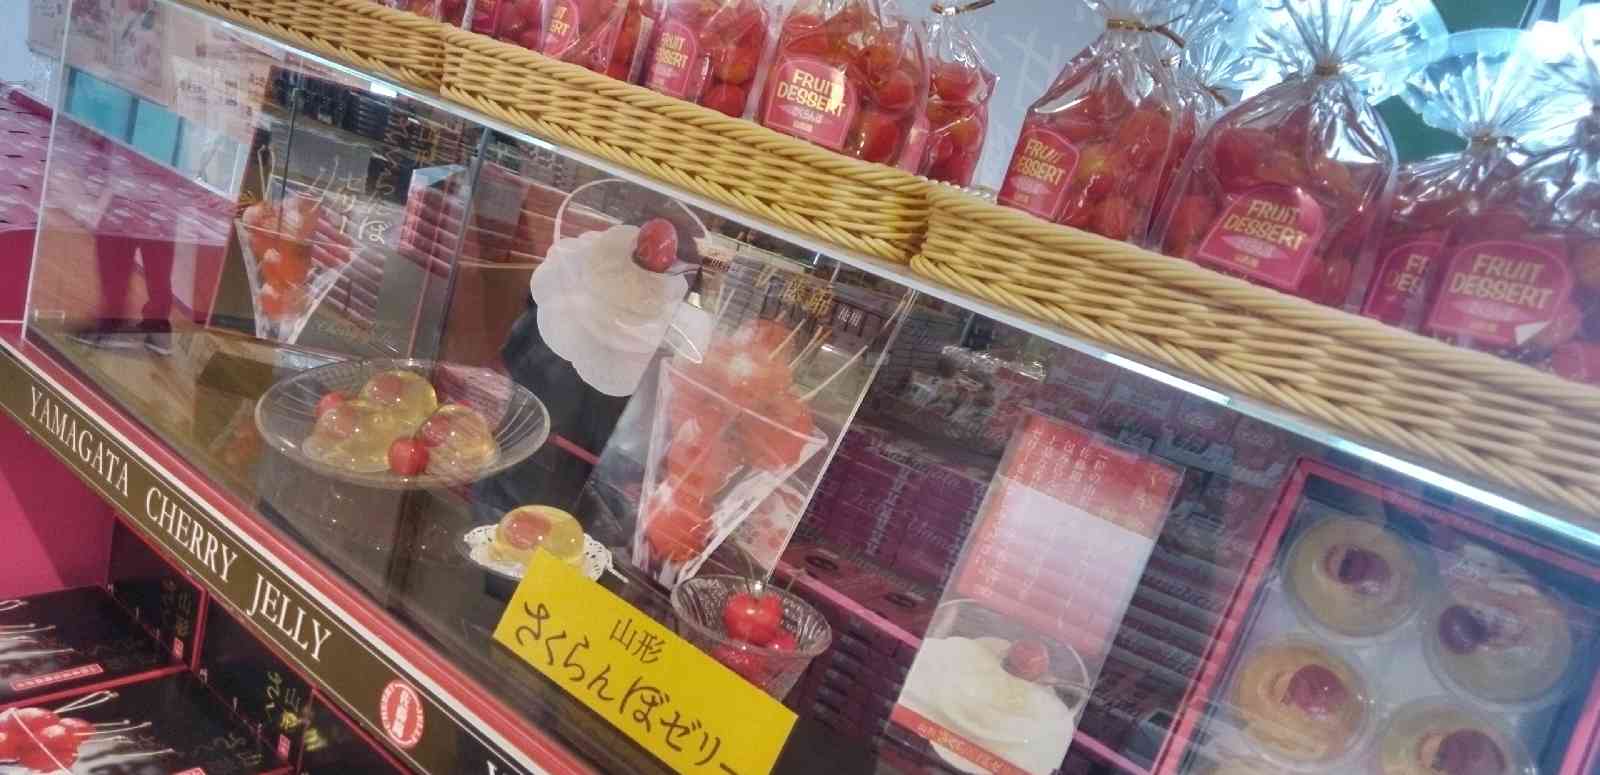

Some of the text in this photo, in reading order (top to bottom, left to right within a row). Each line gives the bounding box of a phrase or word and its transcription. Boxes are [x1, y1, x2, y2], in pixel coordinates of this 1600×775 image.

[776, 81, 846, 118] DESSERT
[1015, 155, 1067, 187] ESSERT
[1247, 200, 1301, 225] FRUIT
[1223, 214, 1308, 251] DESSERT
[1471, 253, 1545, 284] FRUIT
[1449, 271, 1554, 310] DESSERT
[29, 386, 129, 498] YAMAGATA
[146, 487, 238, 583] CHERRY
[246, 573, 332, 662] JELLY
[609, 618, 666, 663] 山形
[515, 600, 739, 775] さくらんぼゼリー
